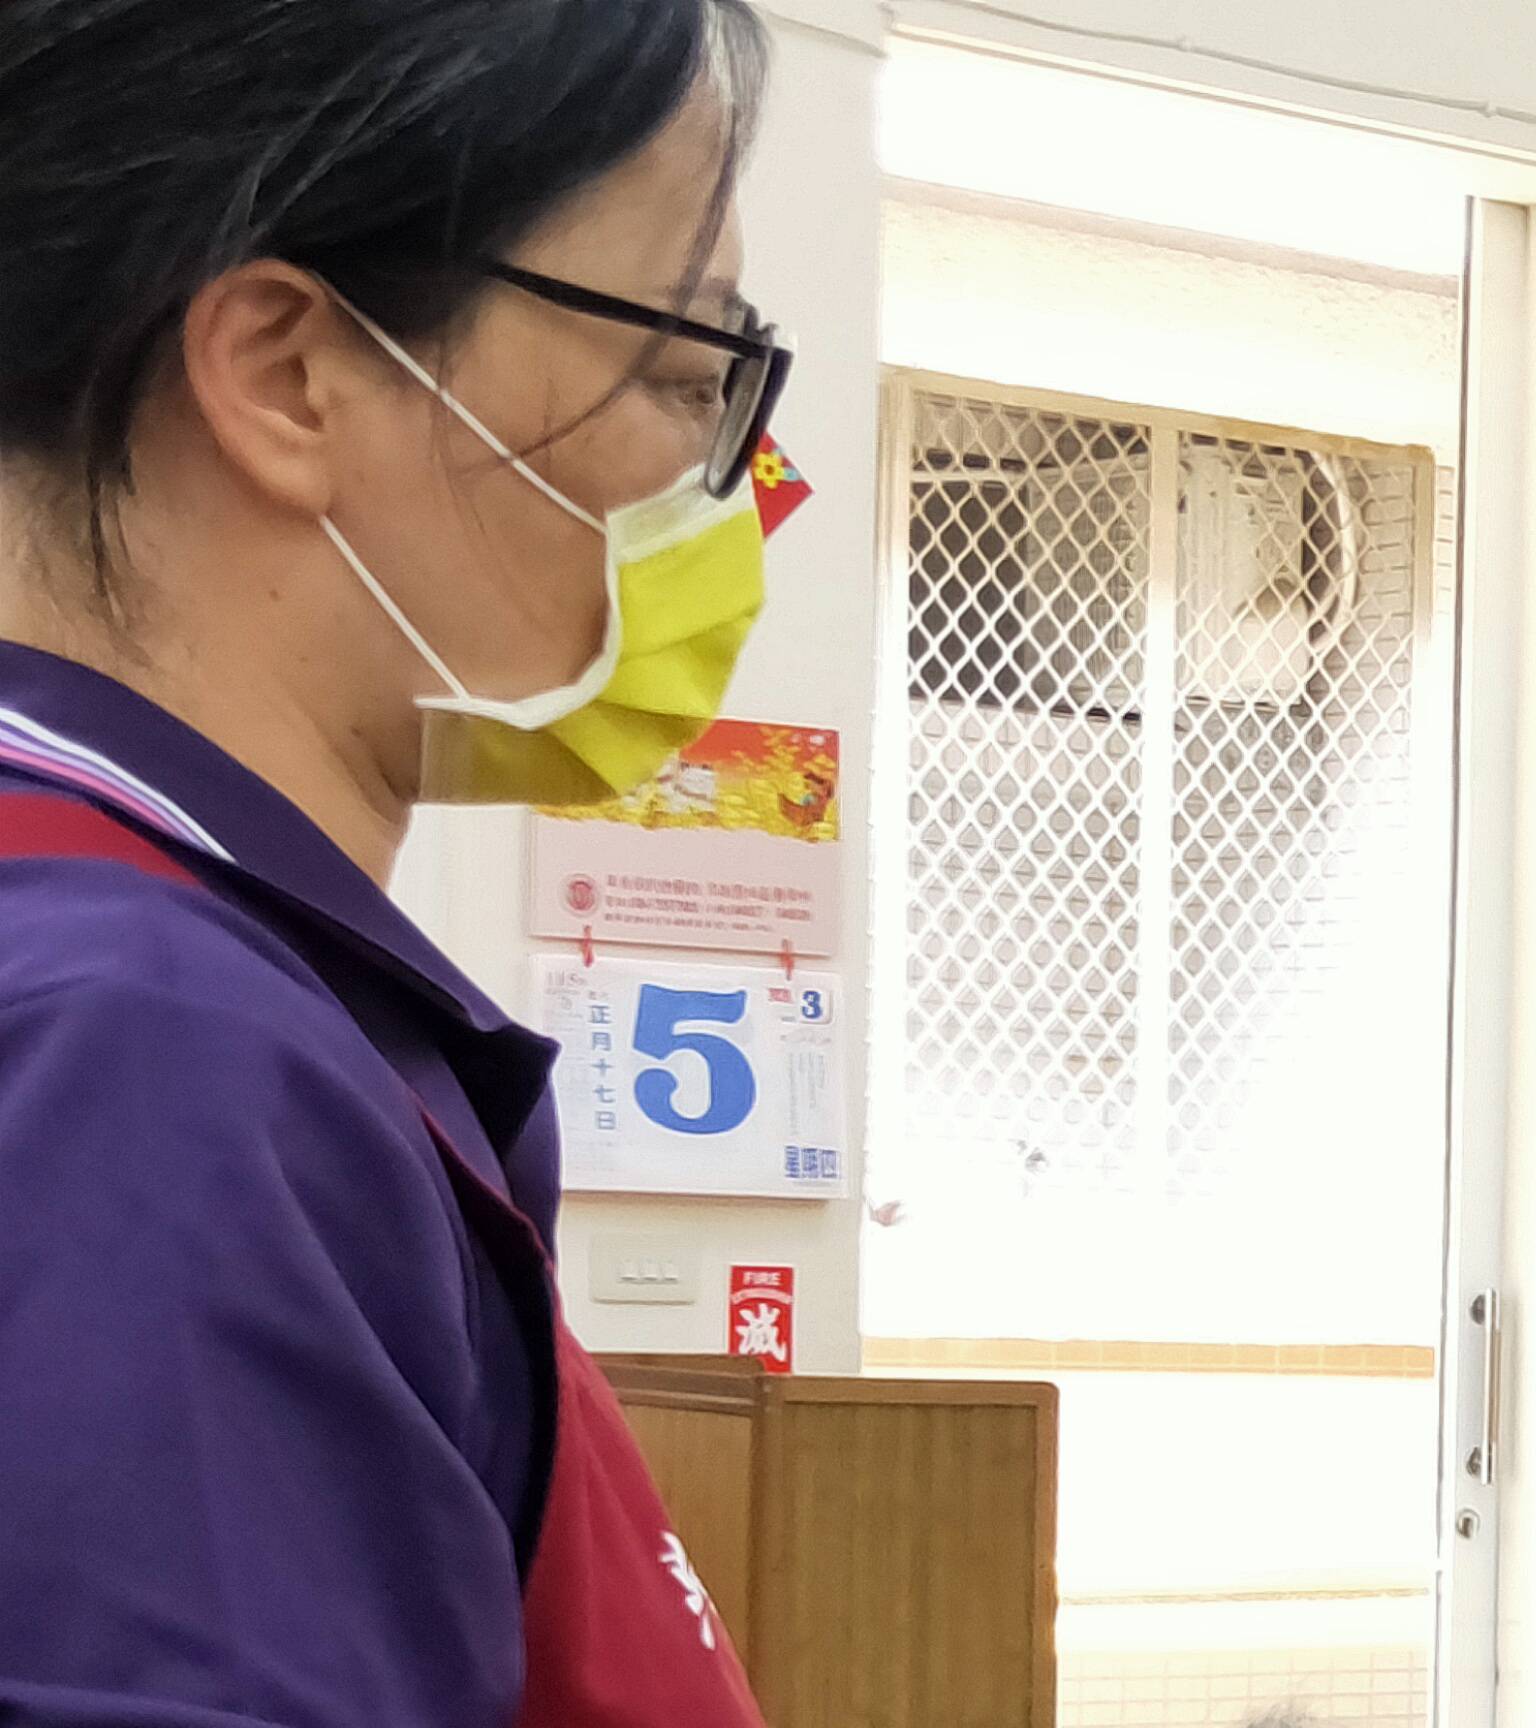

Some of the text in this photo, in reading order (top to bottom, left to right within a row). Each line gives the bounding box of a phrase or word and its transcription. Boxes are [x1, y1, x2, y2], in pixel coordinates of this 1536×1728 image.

[632, 983, 756, 1135] 5
[801, 990, 822, 1020] 3
[742, 1271, 781, 1286] FIRE
